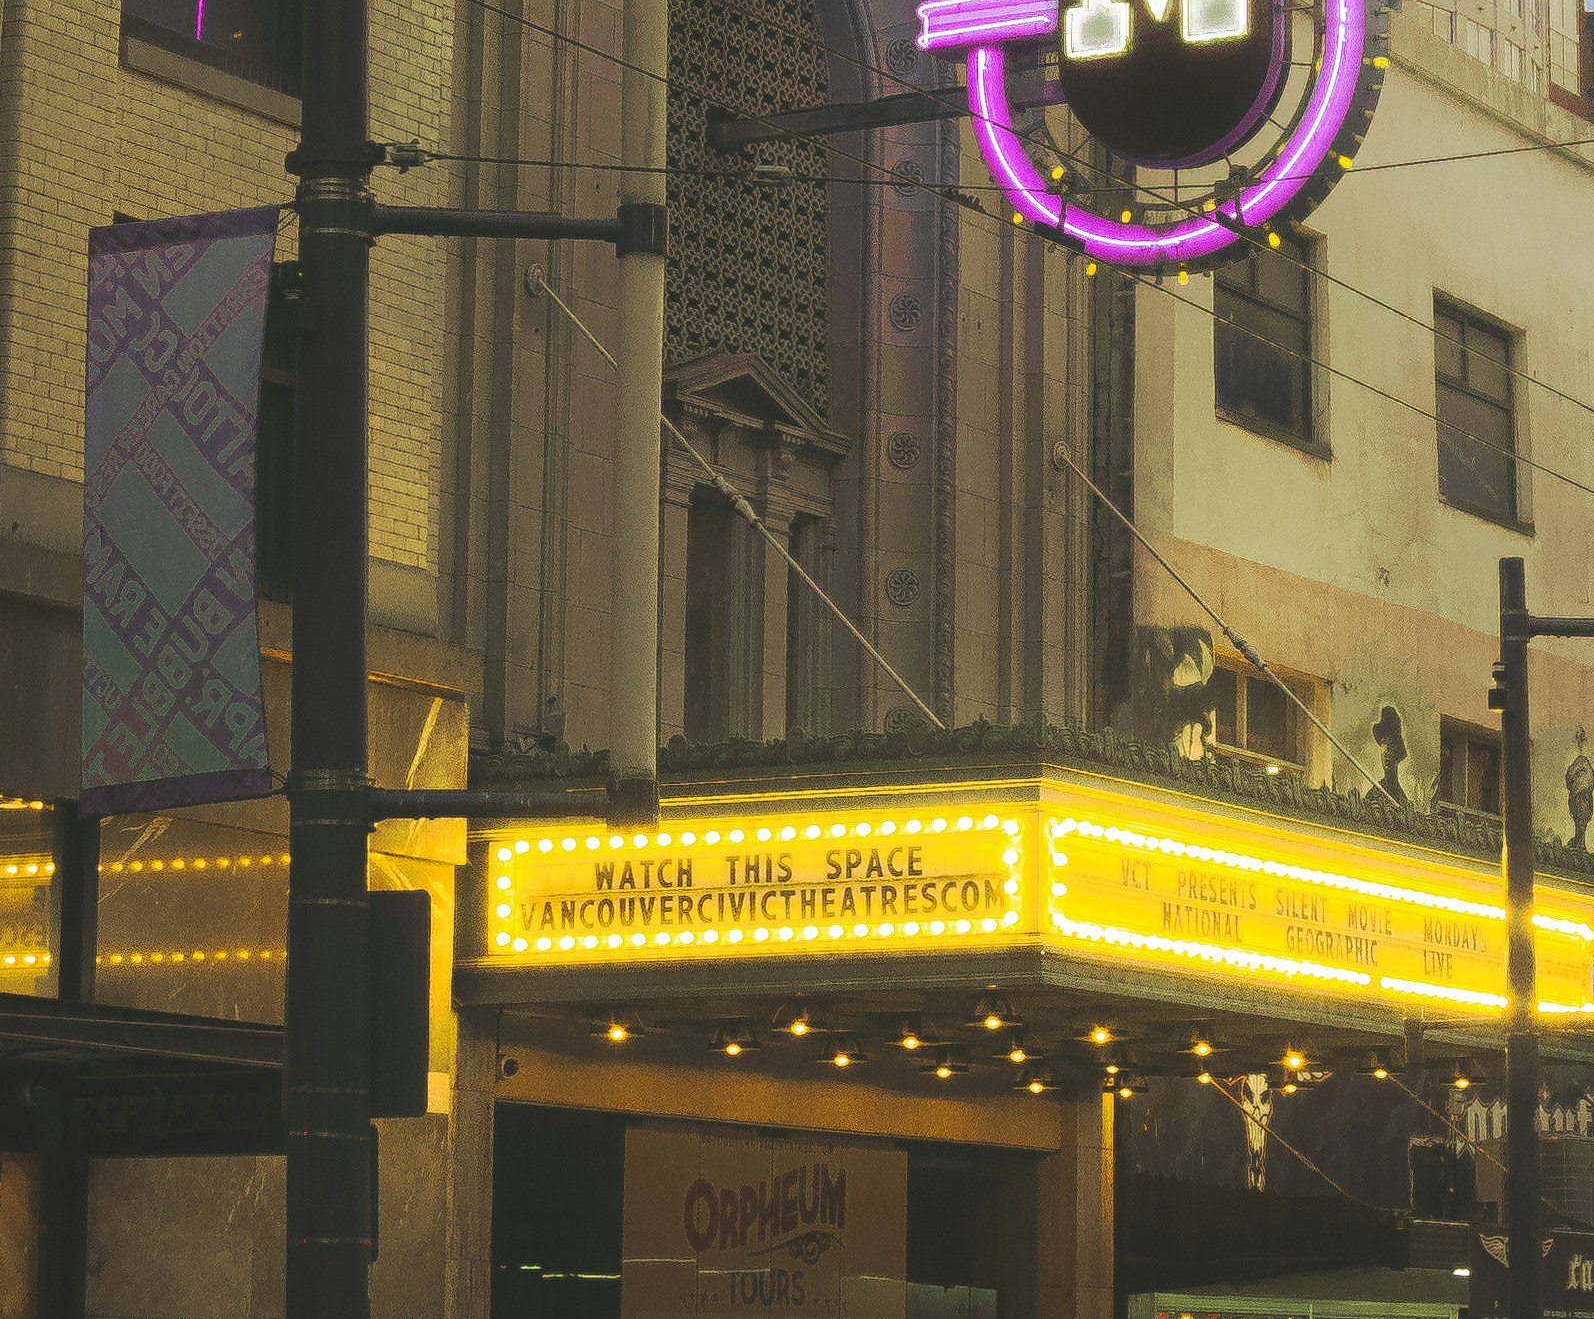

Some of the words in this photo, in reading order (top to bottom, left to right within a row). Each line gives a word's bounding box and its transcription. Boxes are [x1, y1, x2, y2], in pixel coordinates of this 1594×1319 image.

[594, 857, 694, 891] WATCH
[725, 851, 793, 886] THIS
[825, 845, 924, 881] SPACE
[1119, 857, 1152, 892] VCT
[1176, 868, 1258, 911] PRESENTS
[1275, 887, 1329, 925] SILENT
[1347, 901, 1394, 937] MOVIE
[1422, 915, 1489, 955] MONDAYS
[1161, 901, 1244, 944] NATIONAL
[1285, 924, 1380, 968] GEOGRAPHIC
[1422, 949, 1455, 981] LIVE
[682, 1162, 849, 1255] ORPHEUM
[728, 1267, 807, 1308] TOURS
